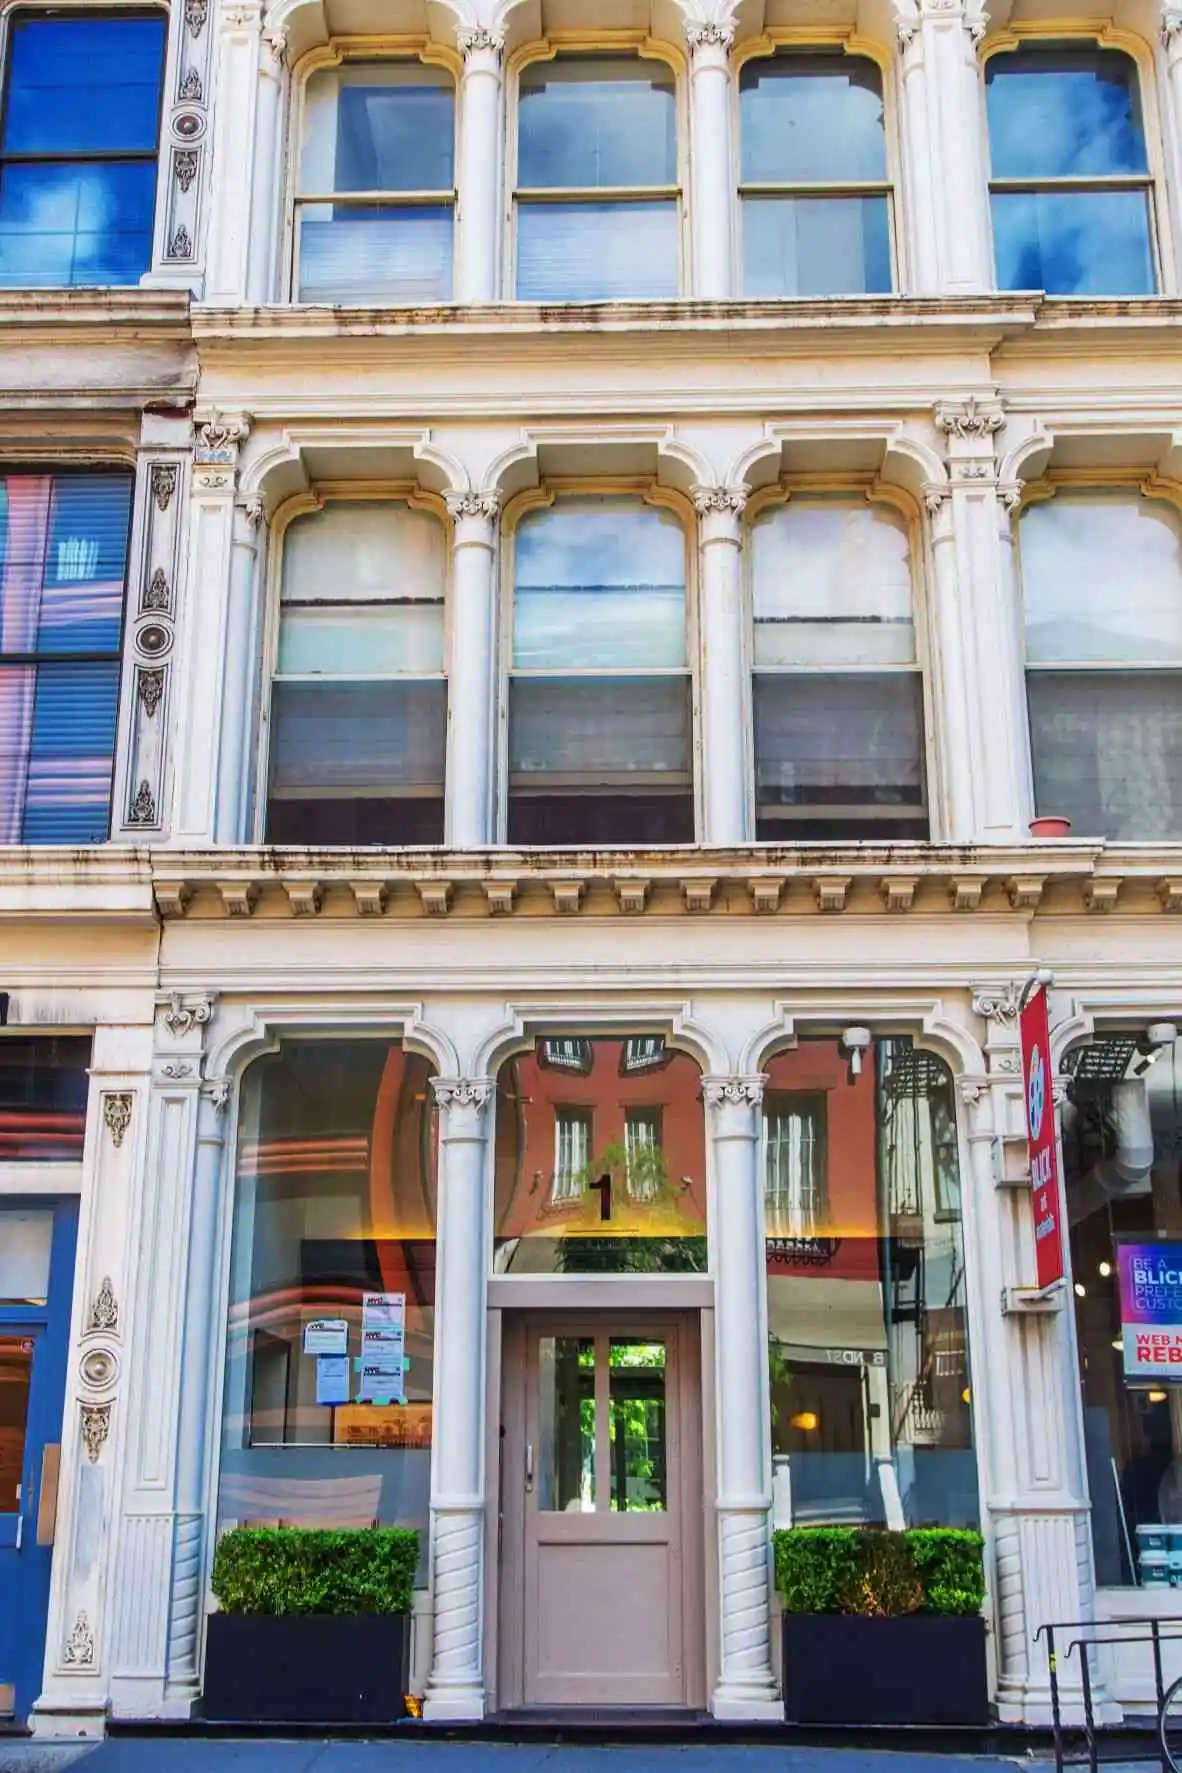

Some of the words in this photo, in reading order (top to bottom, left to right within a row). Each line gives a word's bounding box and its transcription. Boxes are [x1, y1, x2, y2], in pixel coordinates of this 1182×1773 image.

[589, 1174, 611, 1220] 1
[1134, 1258, 1152, 1270] BE
[1158, 1258, 1167, 1269] A
[1136, 1334, 1170, 1345] WEB
